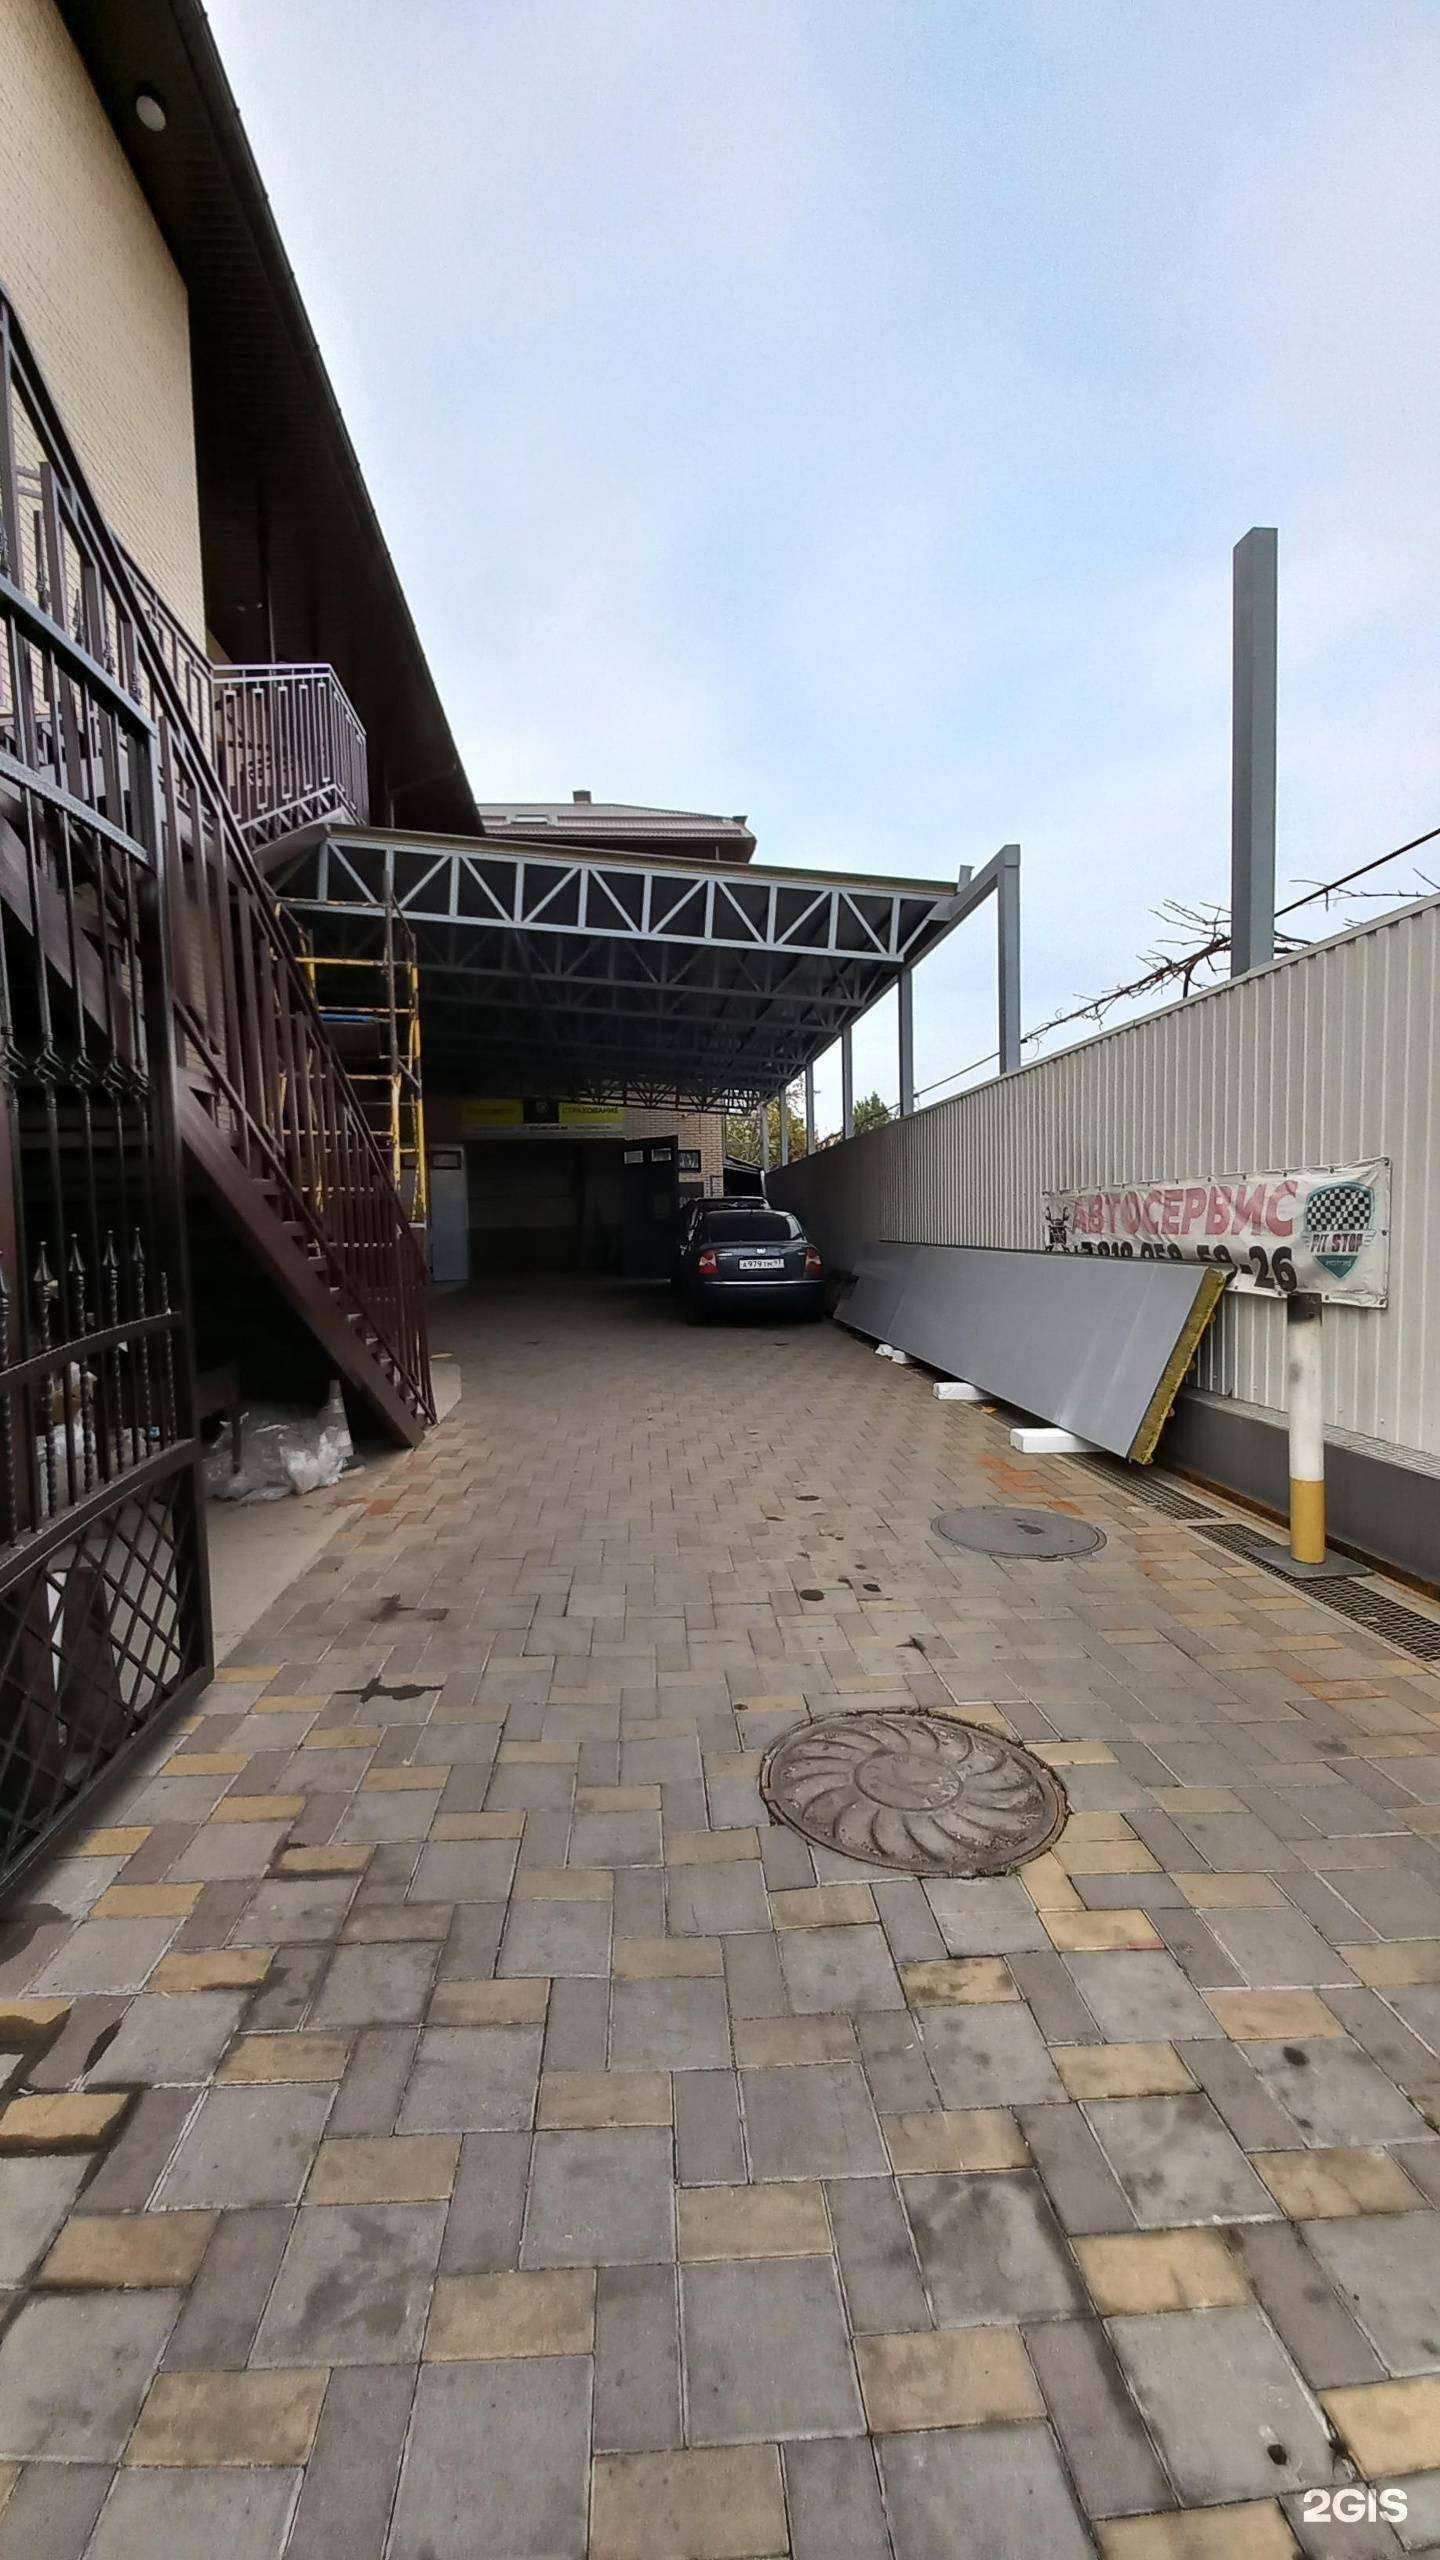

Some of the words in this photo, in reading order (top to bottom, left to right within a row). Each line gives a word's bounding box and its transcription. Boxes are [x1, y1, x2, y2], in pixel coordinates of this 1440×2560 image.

[1072, 1180, 1299, 1238] АВТОСЕРВИС
[1310, 1233, 1329, 1253] PIT
[1331, 1233, 1364, 1253] STOP
